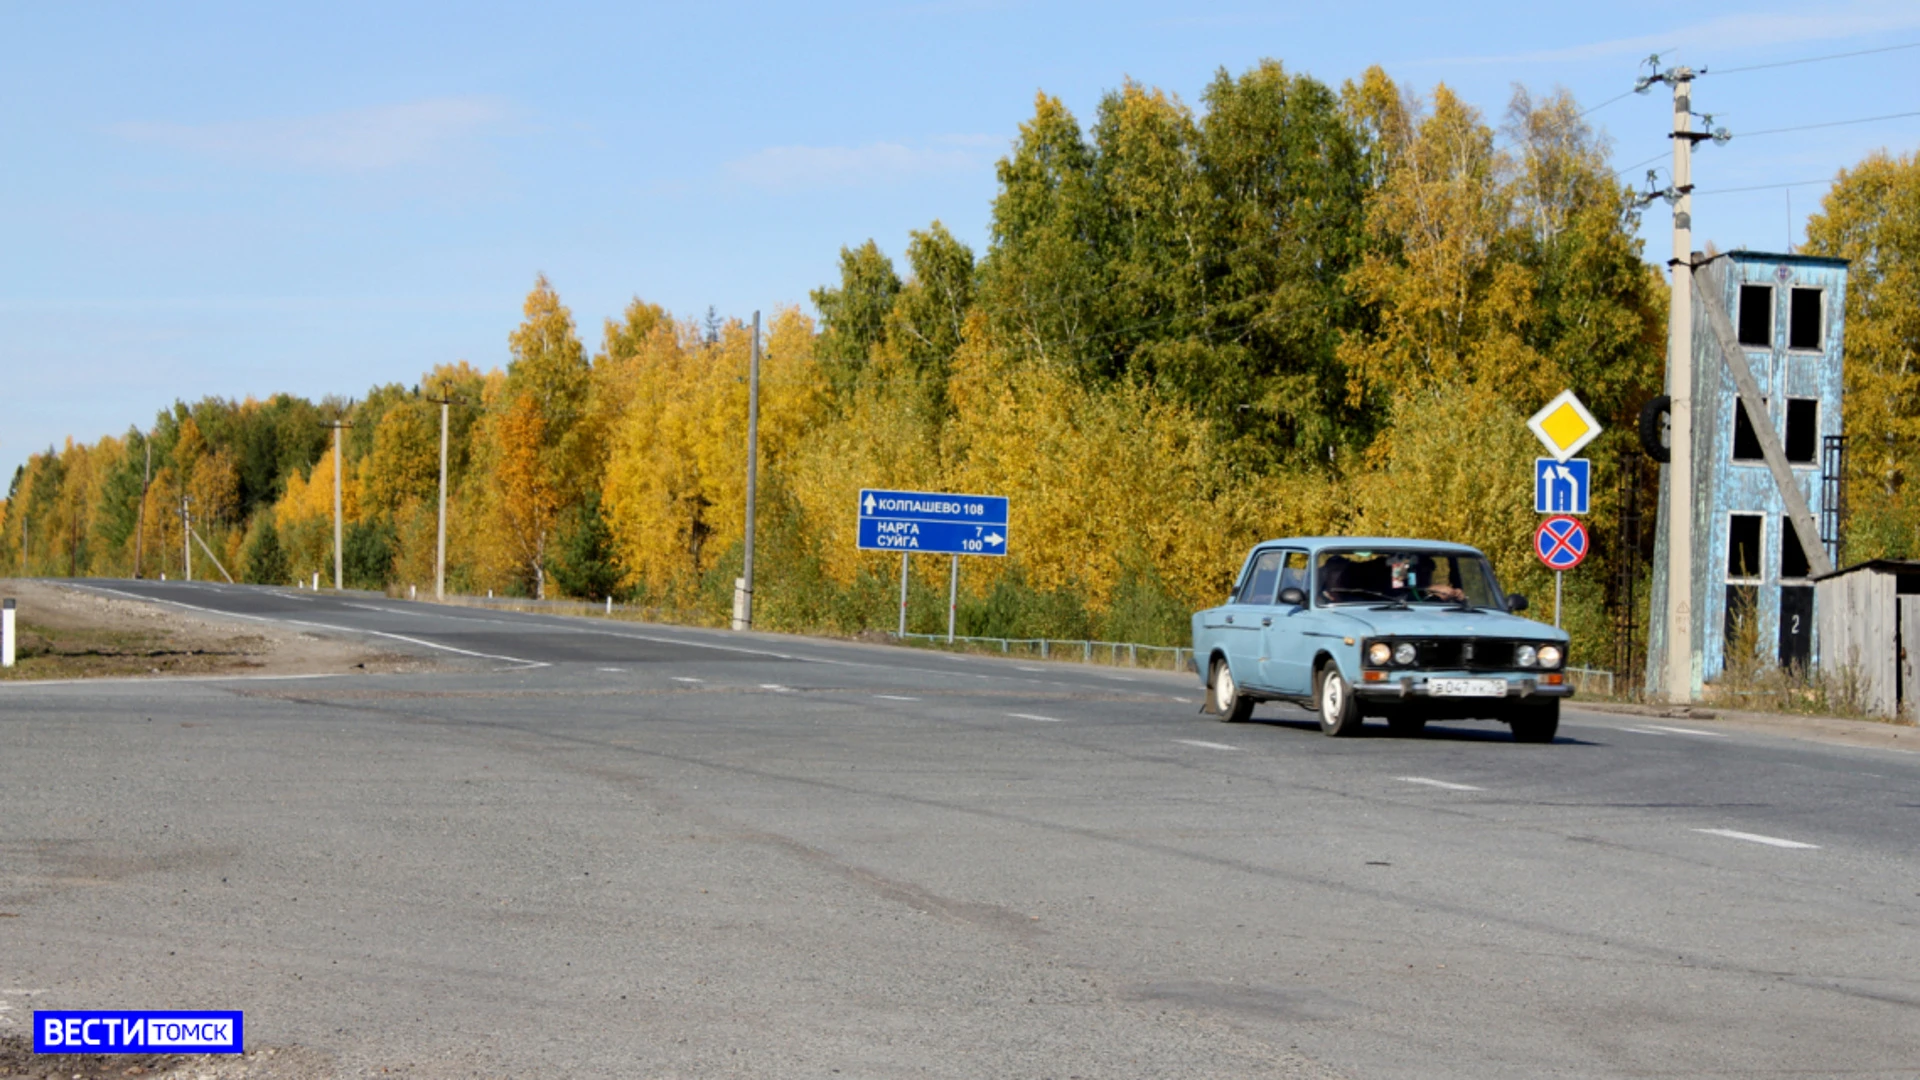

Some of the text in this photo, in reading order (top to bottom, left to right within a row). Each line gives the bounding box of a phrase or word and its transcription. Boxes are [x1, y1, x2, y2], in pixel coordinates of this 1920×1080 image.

[878, 499, 984, 515] КОЛПАШЕВО 108
[877, 522, 983, 537] НАРГА 7
[877, 534, 983, 551] СУЙГА 100
[1791, 614, 1800, 634] 2
